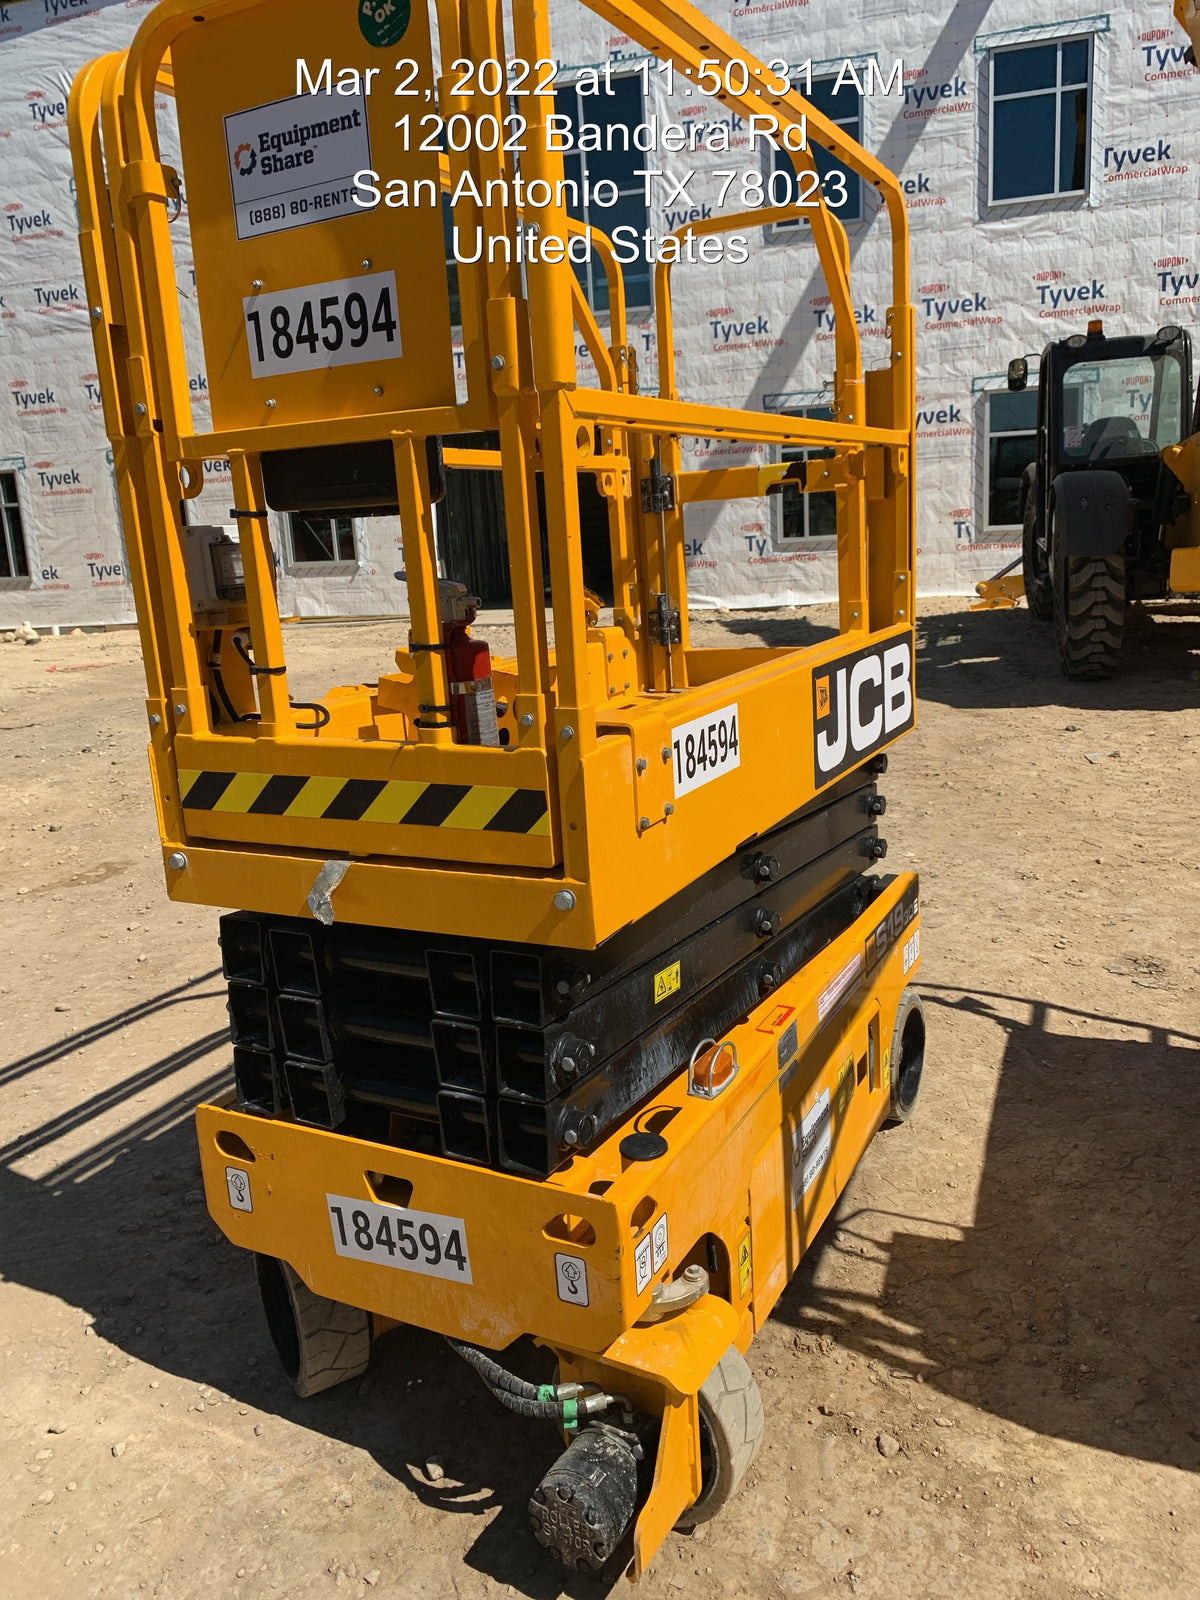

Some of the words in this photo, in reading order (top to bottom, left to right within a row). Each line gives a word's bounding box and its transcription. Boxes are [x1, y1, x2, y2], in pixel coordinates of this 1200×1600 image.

[375, 0, 396, 23] OK
[733, 0, 809, 17] CommercialWrap
[1142, 29, 1170, 41] DUPONT
[1142, 45, 1185, 71] Tyv
[903, 69, 925, 80] UPONT
[1144, 68, 1200, 82] Commerci
[903, 76, 967, 109] Tyvek
[28, 102, 65, 122] Tyve
[903, 101, 976, 119] CommercialWra
[258, 108, 362, 153] Equipment
[1104, 139, 1172, 172] Tyvek
[1104, 164, 1188, 183] CommercialWrap
[7, 209, 51, 234] Tyvek
[249, 204, 286, 226] (888)
[662, 203, 712, 231] yvek
[1158, 257, 1185, 268] DUPONT
[1036, 271, 1062, 281] DUPONT
[1157, 271, 1199, 296] Tyv
[34, 284, 79, 306] Tyvek
[1036, 279, 1105, 308] Tyvek
[922, 292, 987, 320] Tyvek
[1039, 303, 1121, 319] CommercialWrap
[247, 286, 398, 362] 184594
[710, 316, 768, 342] Tyvek
[813, 304, 875, 332] Tyek
[925, 315, 1003, 330] CommercialWrap
[713, 336, 784, 352] CommercialWrap
[12, 388, 55, 409] Tyvek
[916, 404, 961, 430] yvek
[694, 445, 763, 457] CommercialWrap
[37, 469, 80, 490] Tyvek
[956, 541, 1024, 551] CommercialWr
[748, 551, 816, 564] CommercialWrap
[87, 563, 121, 580] Tyve
[817, 643, 912, 772] JCB
[673, 715, 738, 784] 184594
[330, 1206, 467, 1272] 184594
